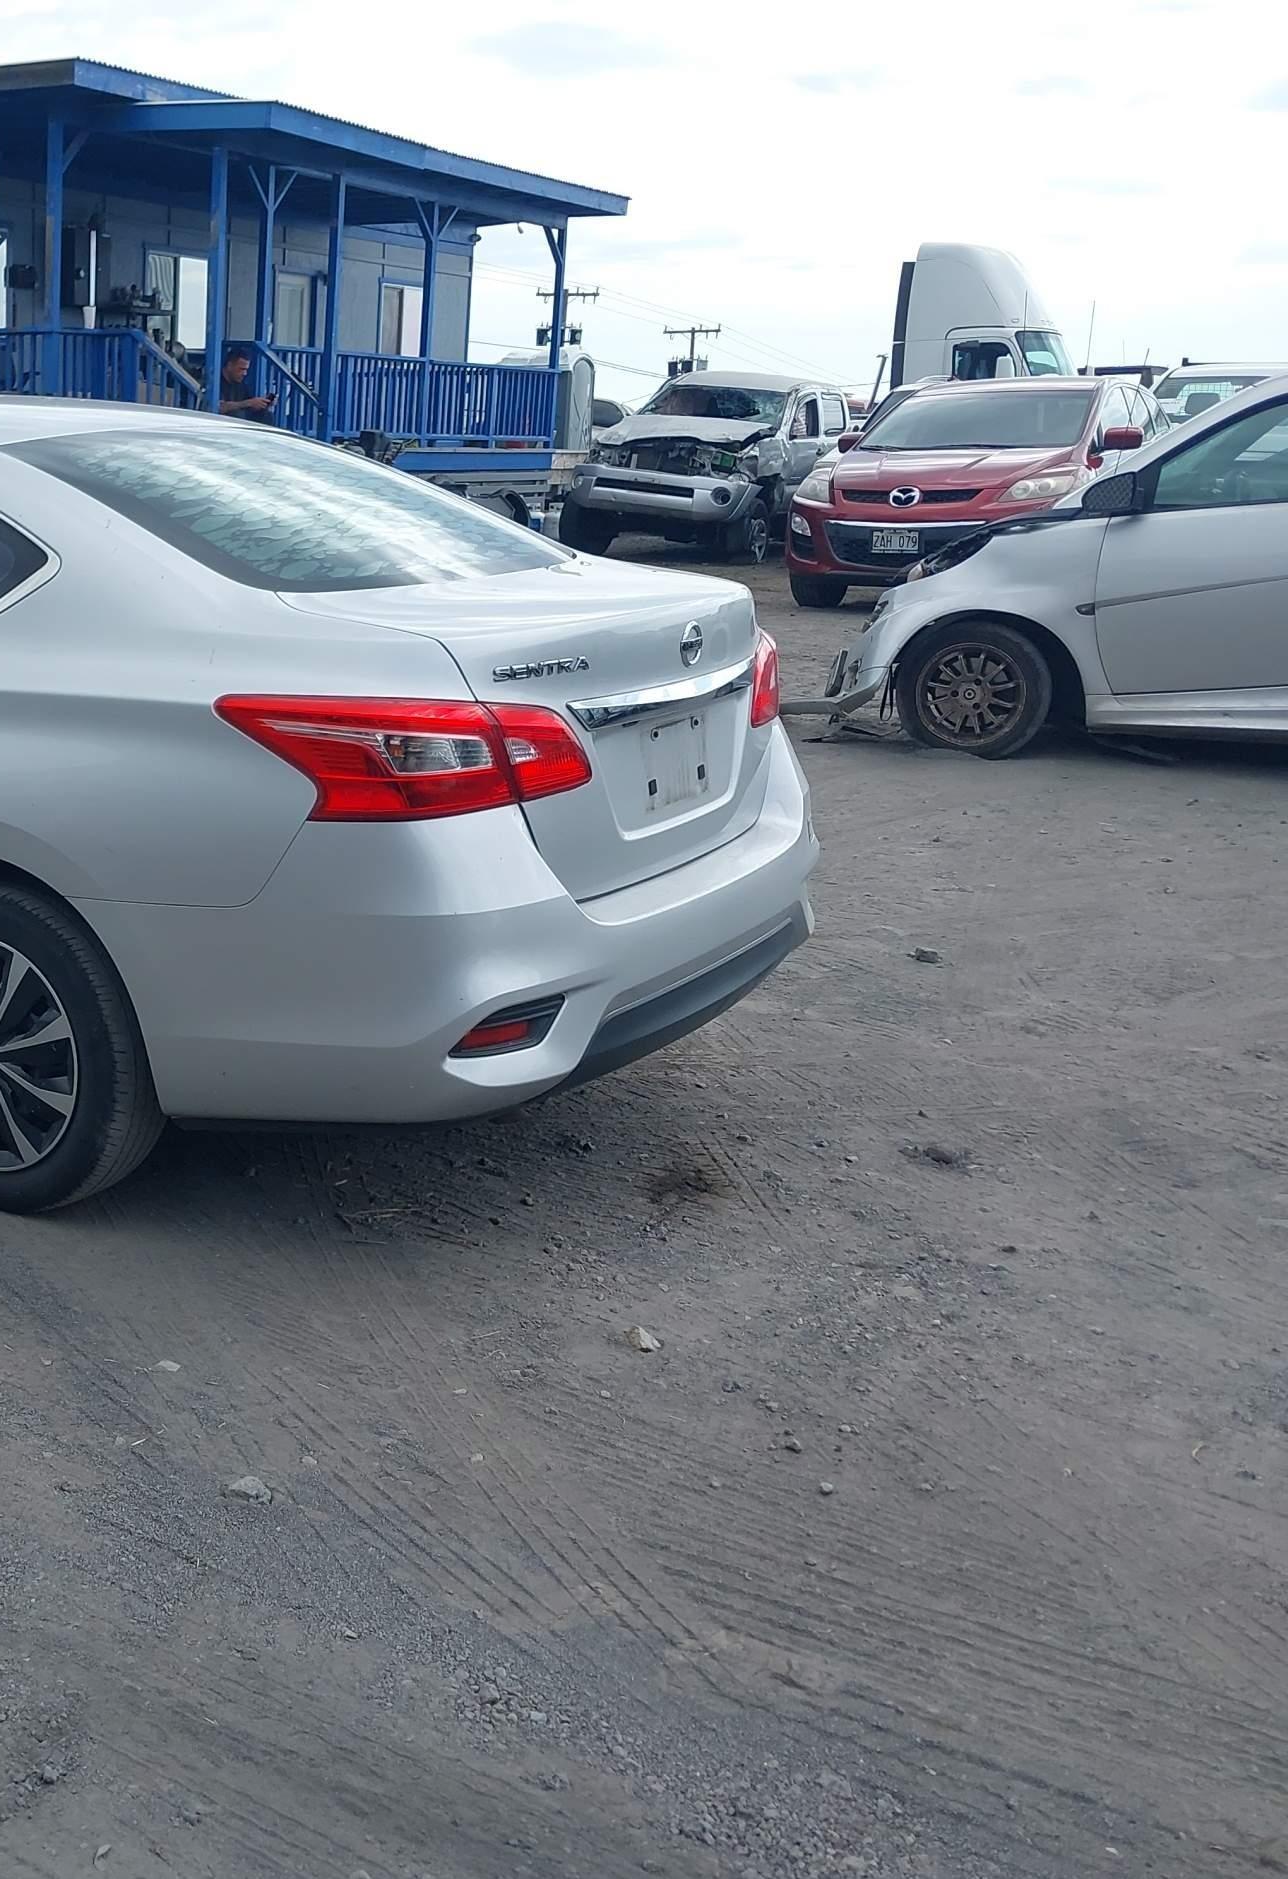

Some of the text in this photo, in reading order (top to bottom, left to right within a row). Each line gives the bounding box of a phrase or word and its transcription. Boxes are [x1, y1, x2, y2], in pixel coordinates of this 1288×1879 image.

[873, 535, 918, 548] ZAH 079
[492, 656, 590, 683] SENTRA
